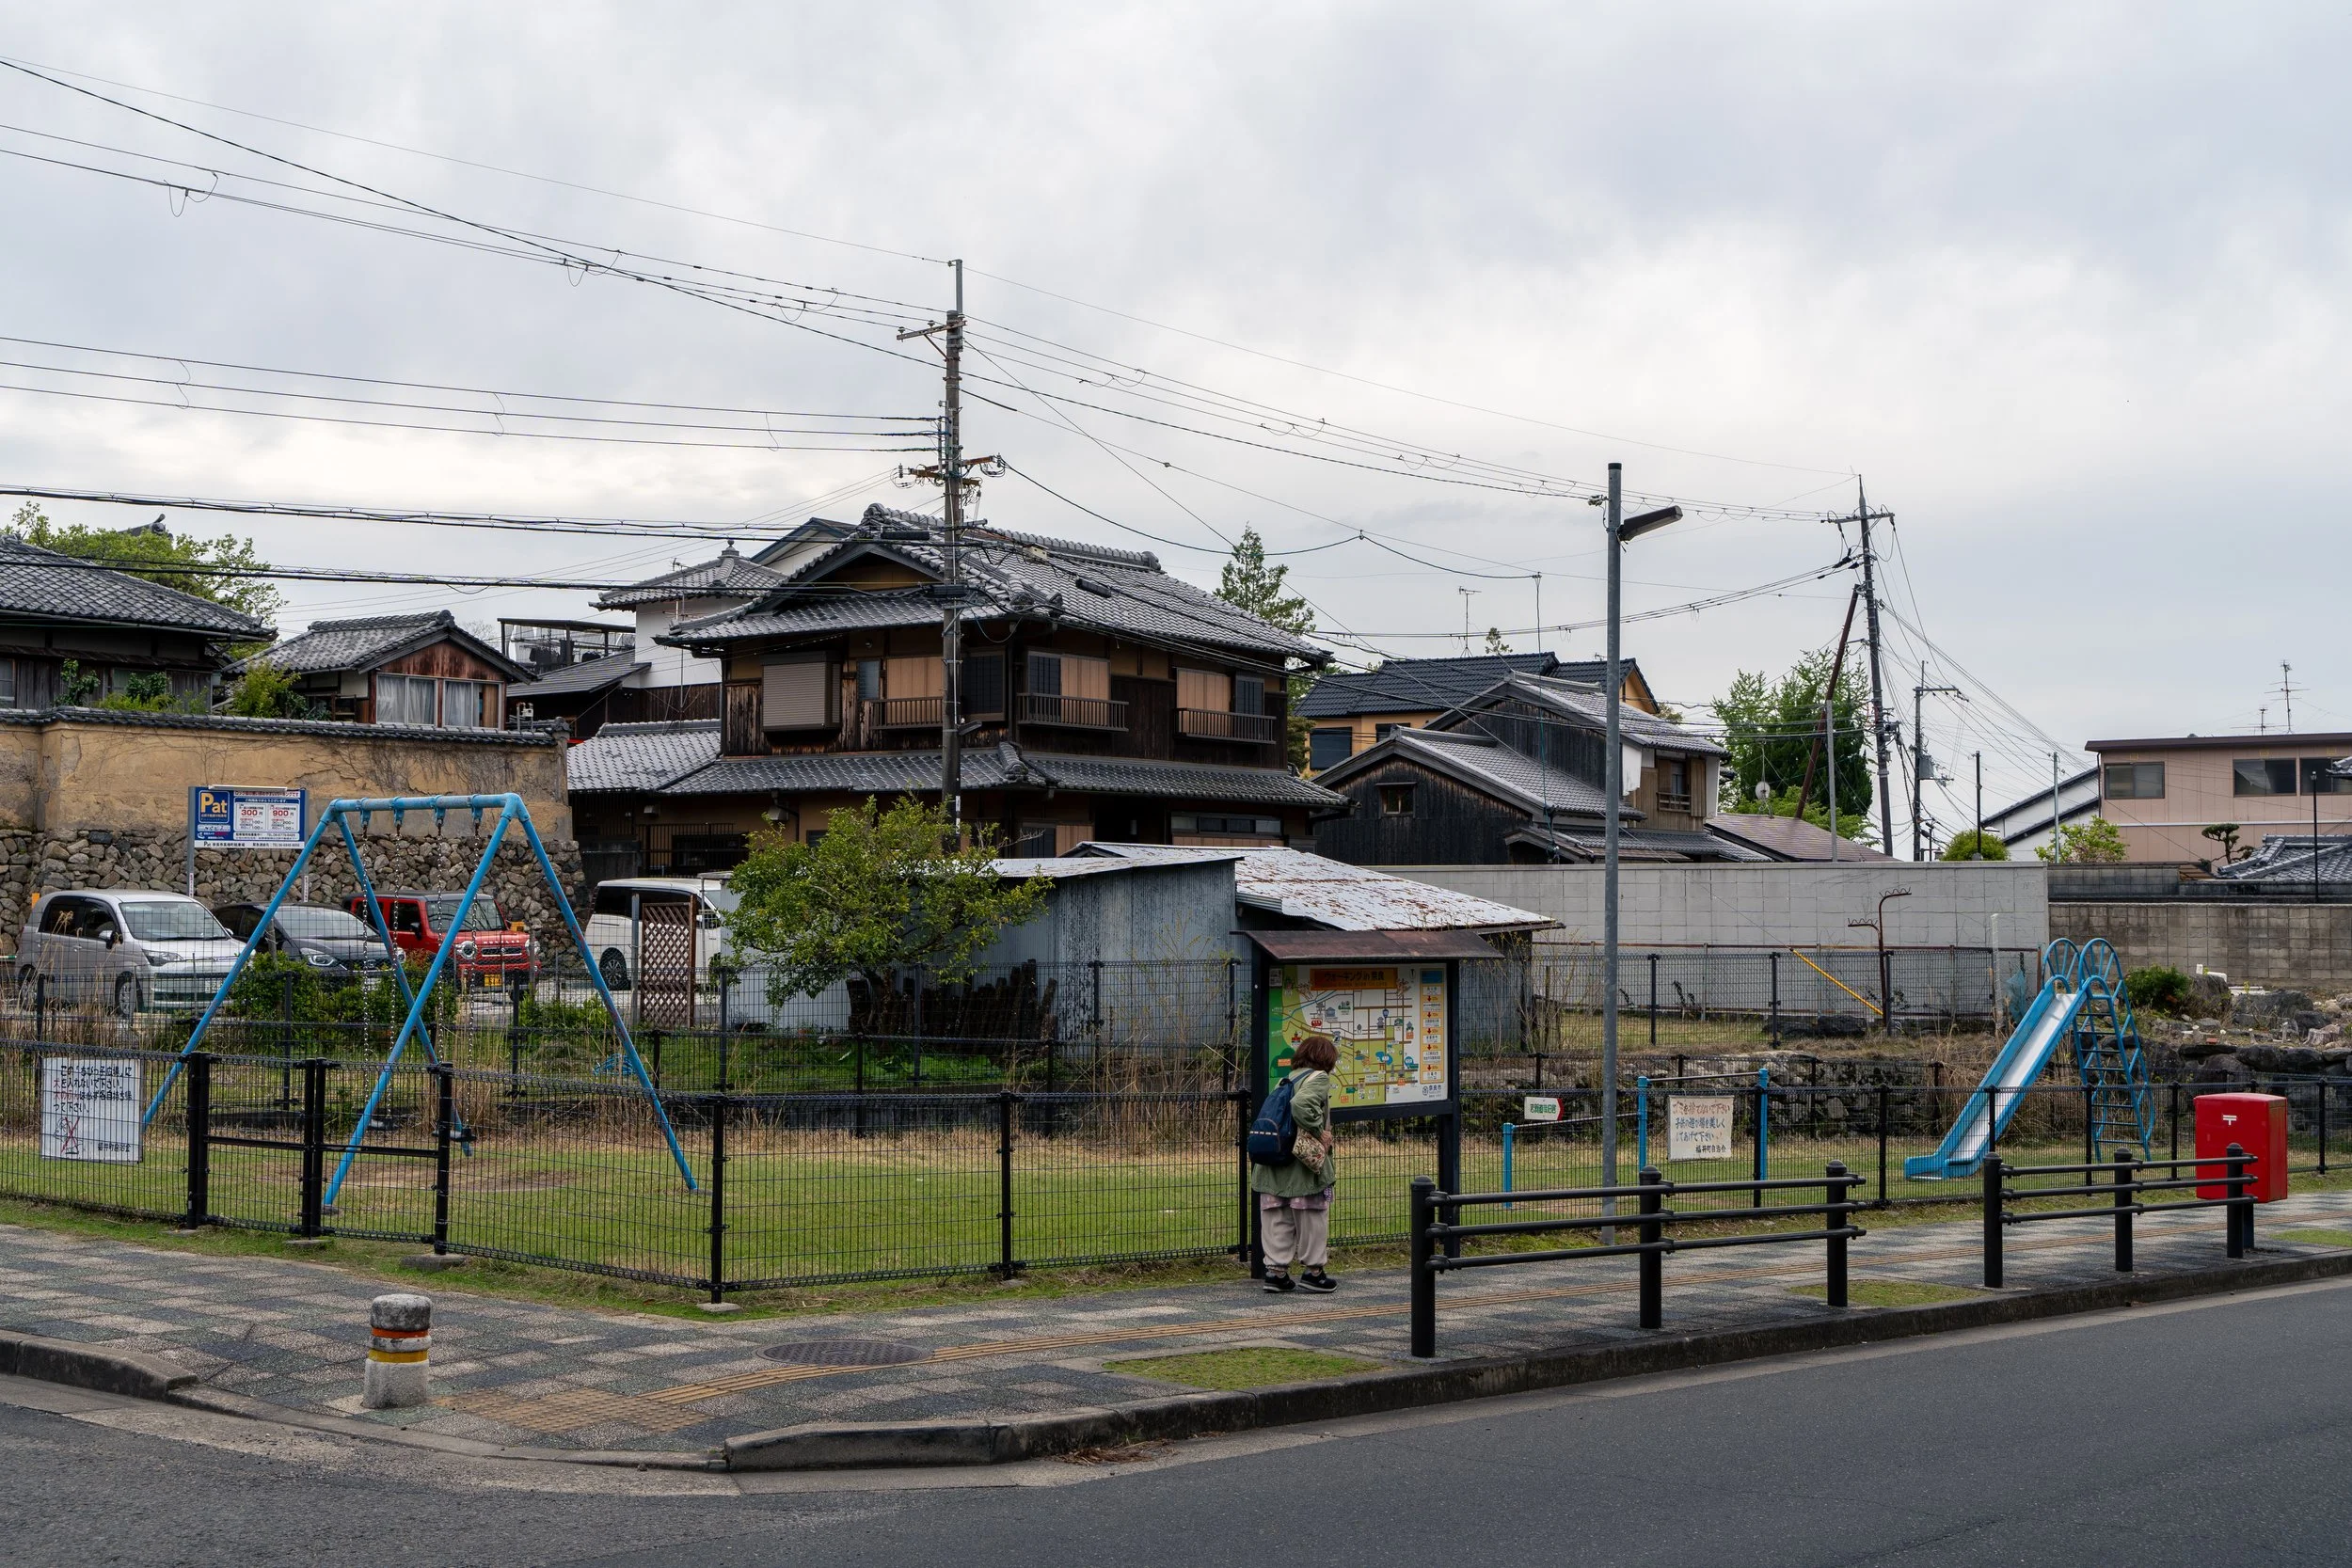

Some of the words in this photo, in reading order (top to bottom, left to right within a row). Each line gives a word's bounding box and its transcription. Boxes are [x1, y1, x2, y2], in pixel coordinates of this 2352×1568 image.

[200, 792, 228, 814] Pat
[1695, 1144, 1727, 1154] 福井町自治会
